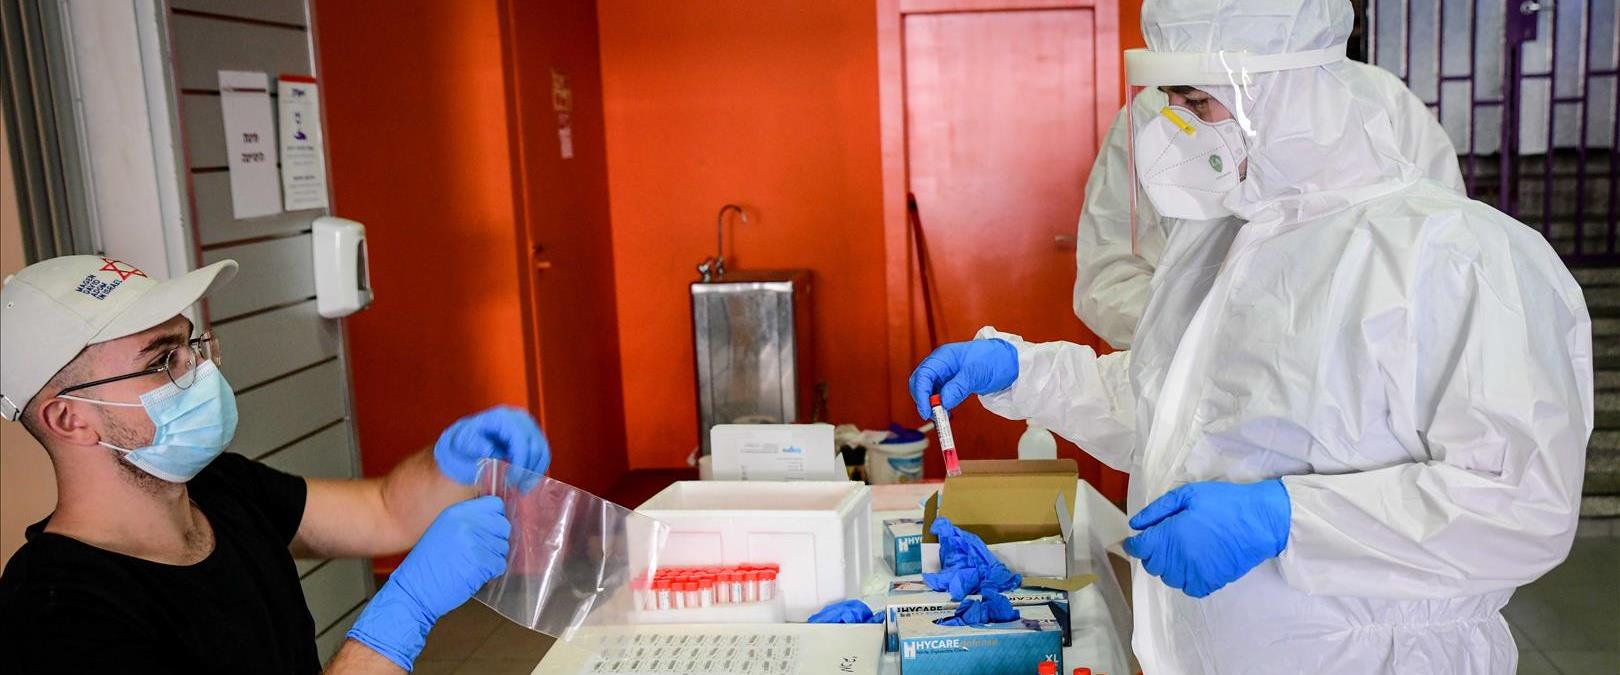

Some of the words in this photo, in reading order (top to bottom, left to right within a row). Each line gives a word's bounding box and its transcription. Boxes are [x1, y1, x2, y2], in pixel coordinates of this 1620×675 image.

[76, 275, 96, 292] MAGEN
[83, 280, 100, 294] DAVID
[91, 282, 107, 298] ADOM
[102, 279, 122, 294] ISRAEL
[916, 639, 960, 650] HYCARE
[1045, 653, 1059, 663] XL
